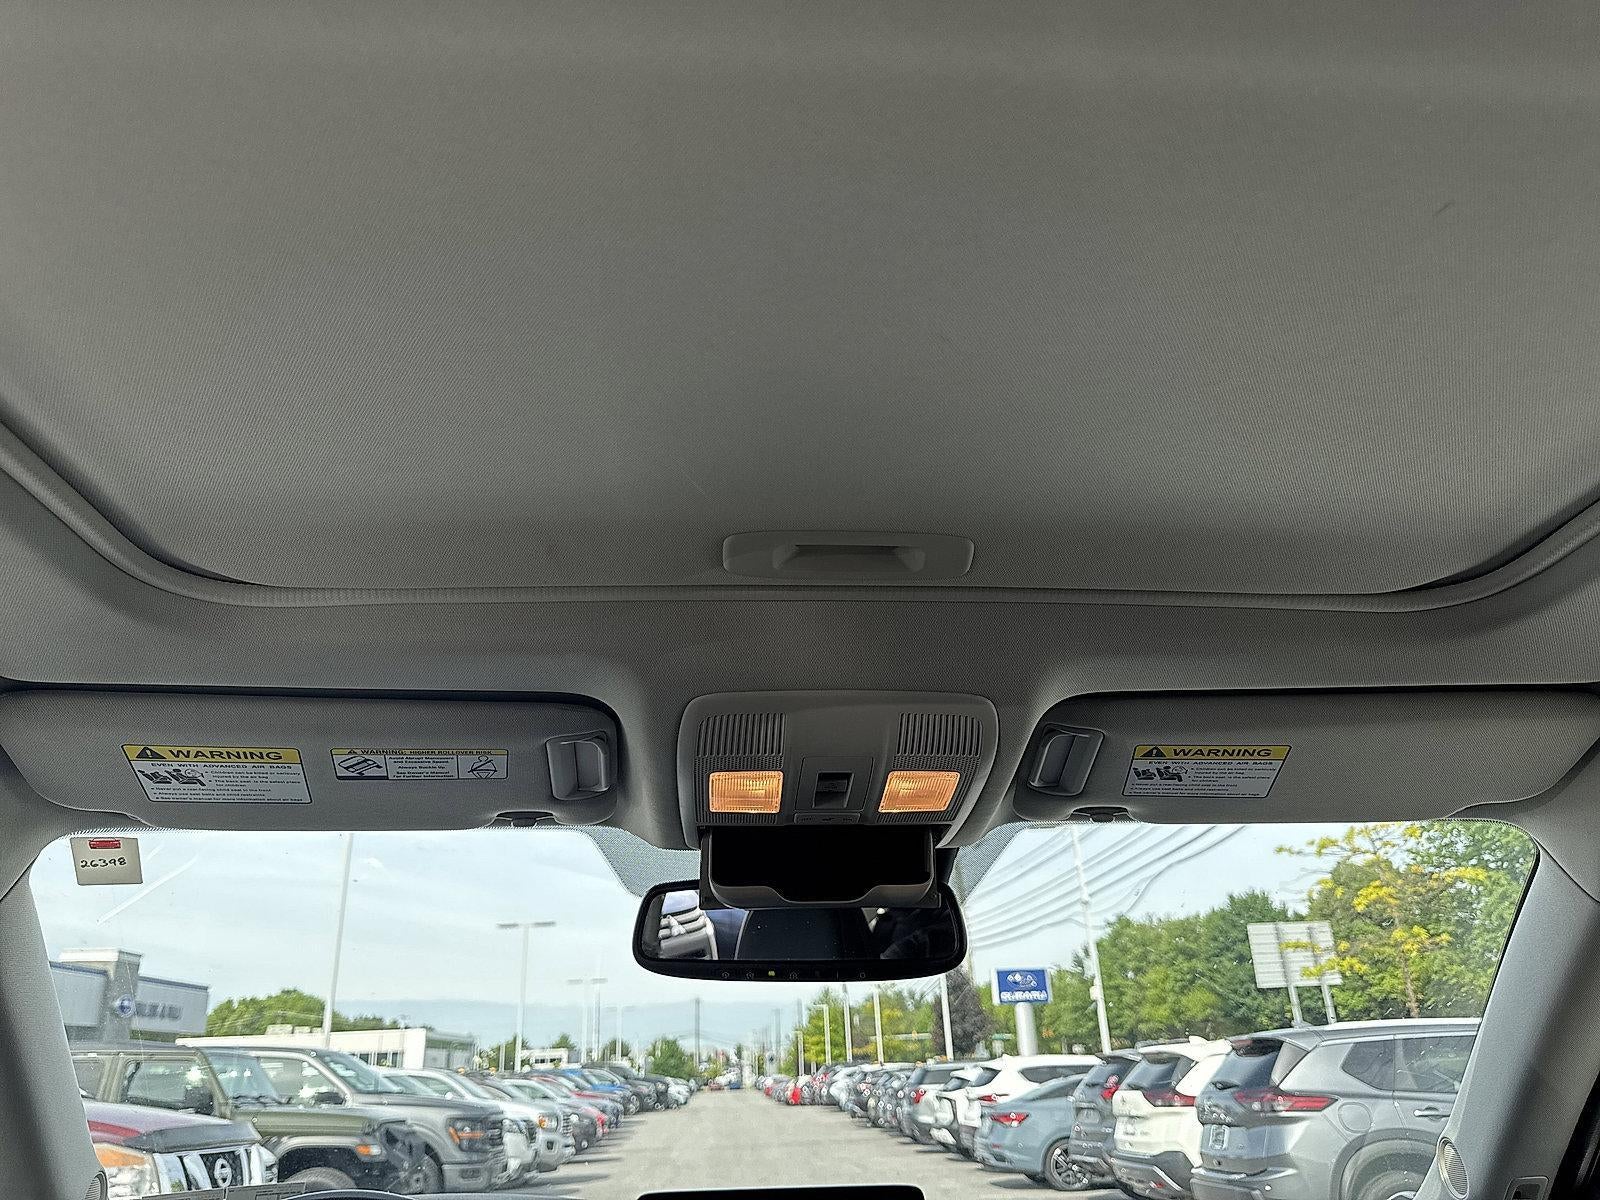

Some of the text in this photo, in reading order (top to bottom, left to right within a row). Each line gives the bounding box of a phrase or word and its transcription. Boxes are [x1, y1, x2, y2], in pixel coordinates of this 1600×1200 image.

[168, 750, 283, 760] WARNING
[1172, 748, 1273, 758] WARNING
[80, 856, 126, 868] 26398
